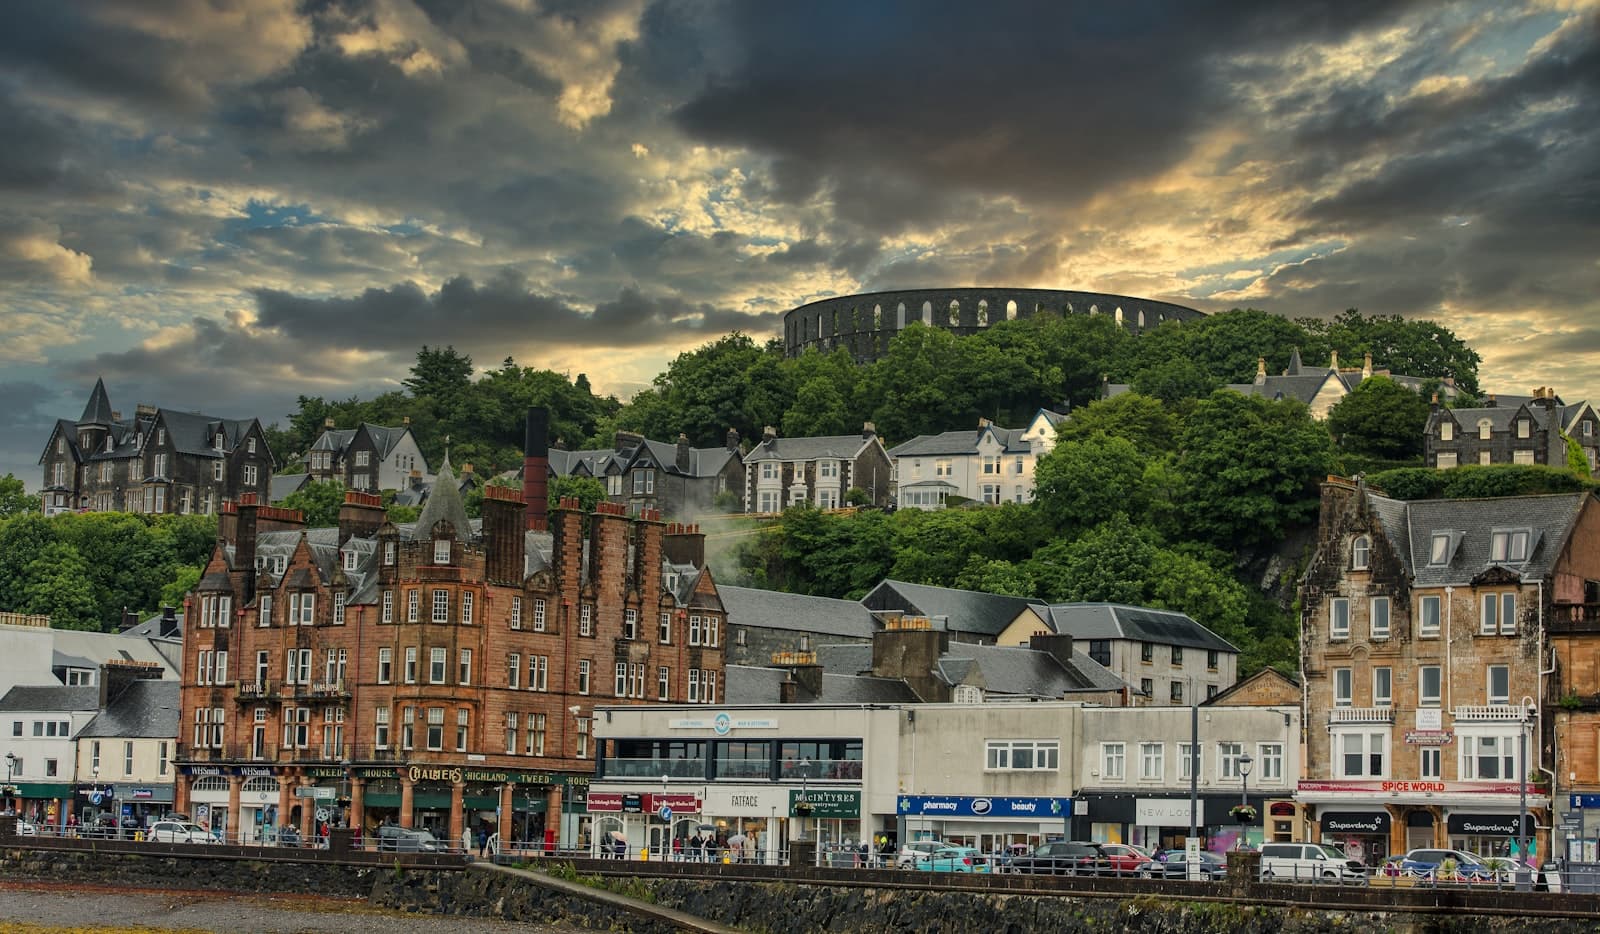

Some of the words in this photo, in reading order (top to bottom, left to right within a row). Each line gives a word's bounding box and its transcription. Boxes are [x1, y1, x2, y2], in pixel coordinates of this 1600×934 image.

[191, 767, 220, 775] WHSmith
[241, 767, 271, 776] WHSmith
[315, 768, 343, 777] TWEED
[364, 769, 393, 778] HOUSE
[409, 766, 462, 783] CHALMERS
[467, 773, 506, 782] HIGHLAND
[521, 775, 549, 784] TWEED
[568, 776, 590, 786] HOUS
[1382, 782, 1409, 791] SPICE
[1412, 783, 1445, 791] WORLD
[731, 795, 758, 807] FATFACE
[923, 801, 957, 811] pharmacy
[1011, 802, 1036, 812] beauty
[1140, 808, 1162, 817] NEW
[1169, 808, 1199, 818] LOO
[1329, 821, 1378, 831] Superdrug
[1463, 822, 1516, 832] Superdrug
